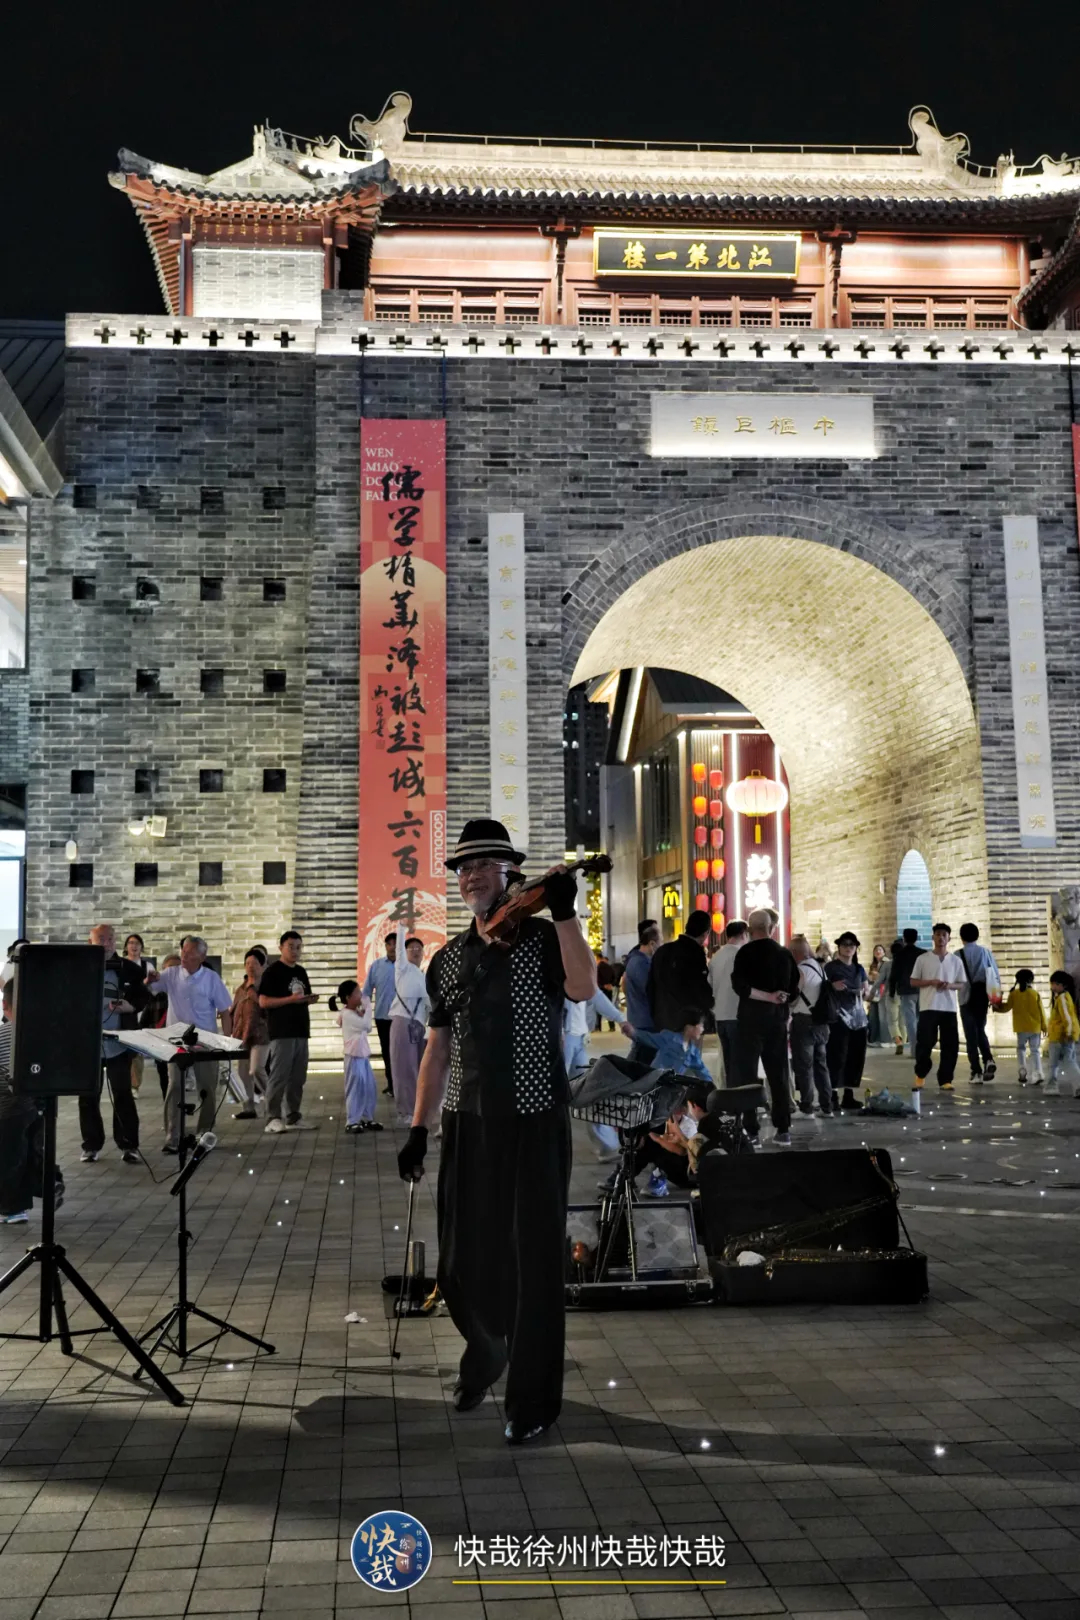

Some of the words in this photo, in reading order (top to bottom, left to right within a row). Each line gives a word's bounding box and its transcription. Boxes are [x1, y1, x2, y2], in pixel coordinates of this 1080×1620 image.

[365, 447, 394, 458] WEN
[365, 461, 400, 473] MIAO
[433, 812, 444, 876] GOODLUCK
